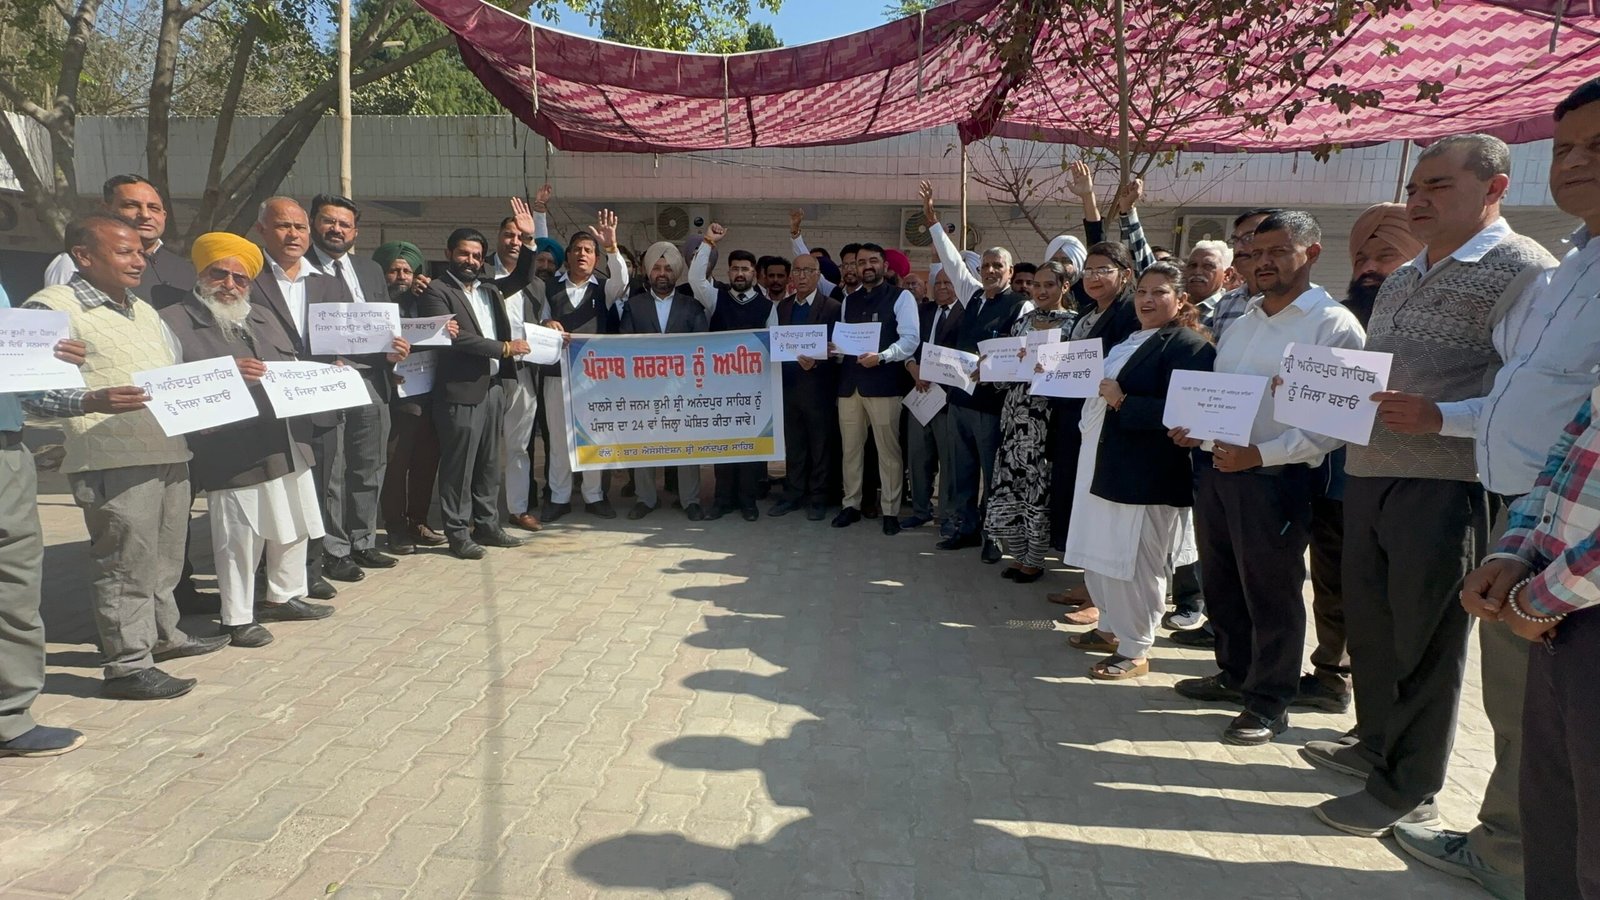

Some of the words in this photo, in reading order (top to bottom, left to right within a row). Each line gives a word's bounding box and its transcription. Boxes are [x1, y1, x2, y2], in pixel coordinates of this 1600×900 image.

[360, 310, 383, 318] ਸਾਹਿਬ
[1076, 348, 1098, 360] ਸਾਹਿਬ
[278, 369, 318, 380] ਅਨੰਦਪੁਰ
[582, 350, 626, 380] ਪੰਜਾਬ
[632, 354, 685, 379] ਸਰਕਾਰ
[692, 347, 705, 388] ਨੂੰ
[712, 345, 763, 375] ਅਪੀਲ
[1297, 356, 1339, 378] ਅਨੰਦਪੁਰ
[1341, 365, 1378, 384] ਸਾਹਿਬ
[156, 377, 201, 390] ਅਨੰਦਪੁਰ
[203, 369, 234, 381] ਸਾਹਿਬ
[1288, 382, 1298, 402] ਨੂੰ
[588, 397, 613, 412] ਖਾਲਸੇ
[616, 397, 626, 411] ਦੀ
[629, 400, 650, 410] ਜਨਮ
[653, 395, 670, 414] ਭੂਮੀ
[687, 393, 723, 411] ਅਨੰਦਪੁਰ
[726, 392, 752, 407] ਸਾਹਿਬ
[754, 391, 762, 410] ਨੂੰ
[590, 418, 615, 432] ਪੰਜਾਬ
[617, 420, 628, 431] ਦਾ
[632, 420, 644, 431] 24
[647, 417, 657, 429] ਵਾਂ
[712, 413, 733, 427] ਕੀਤਾ
